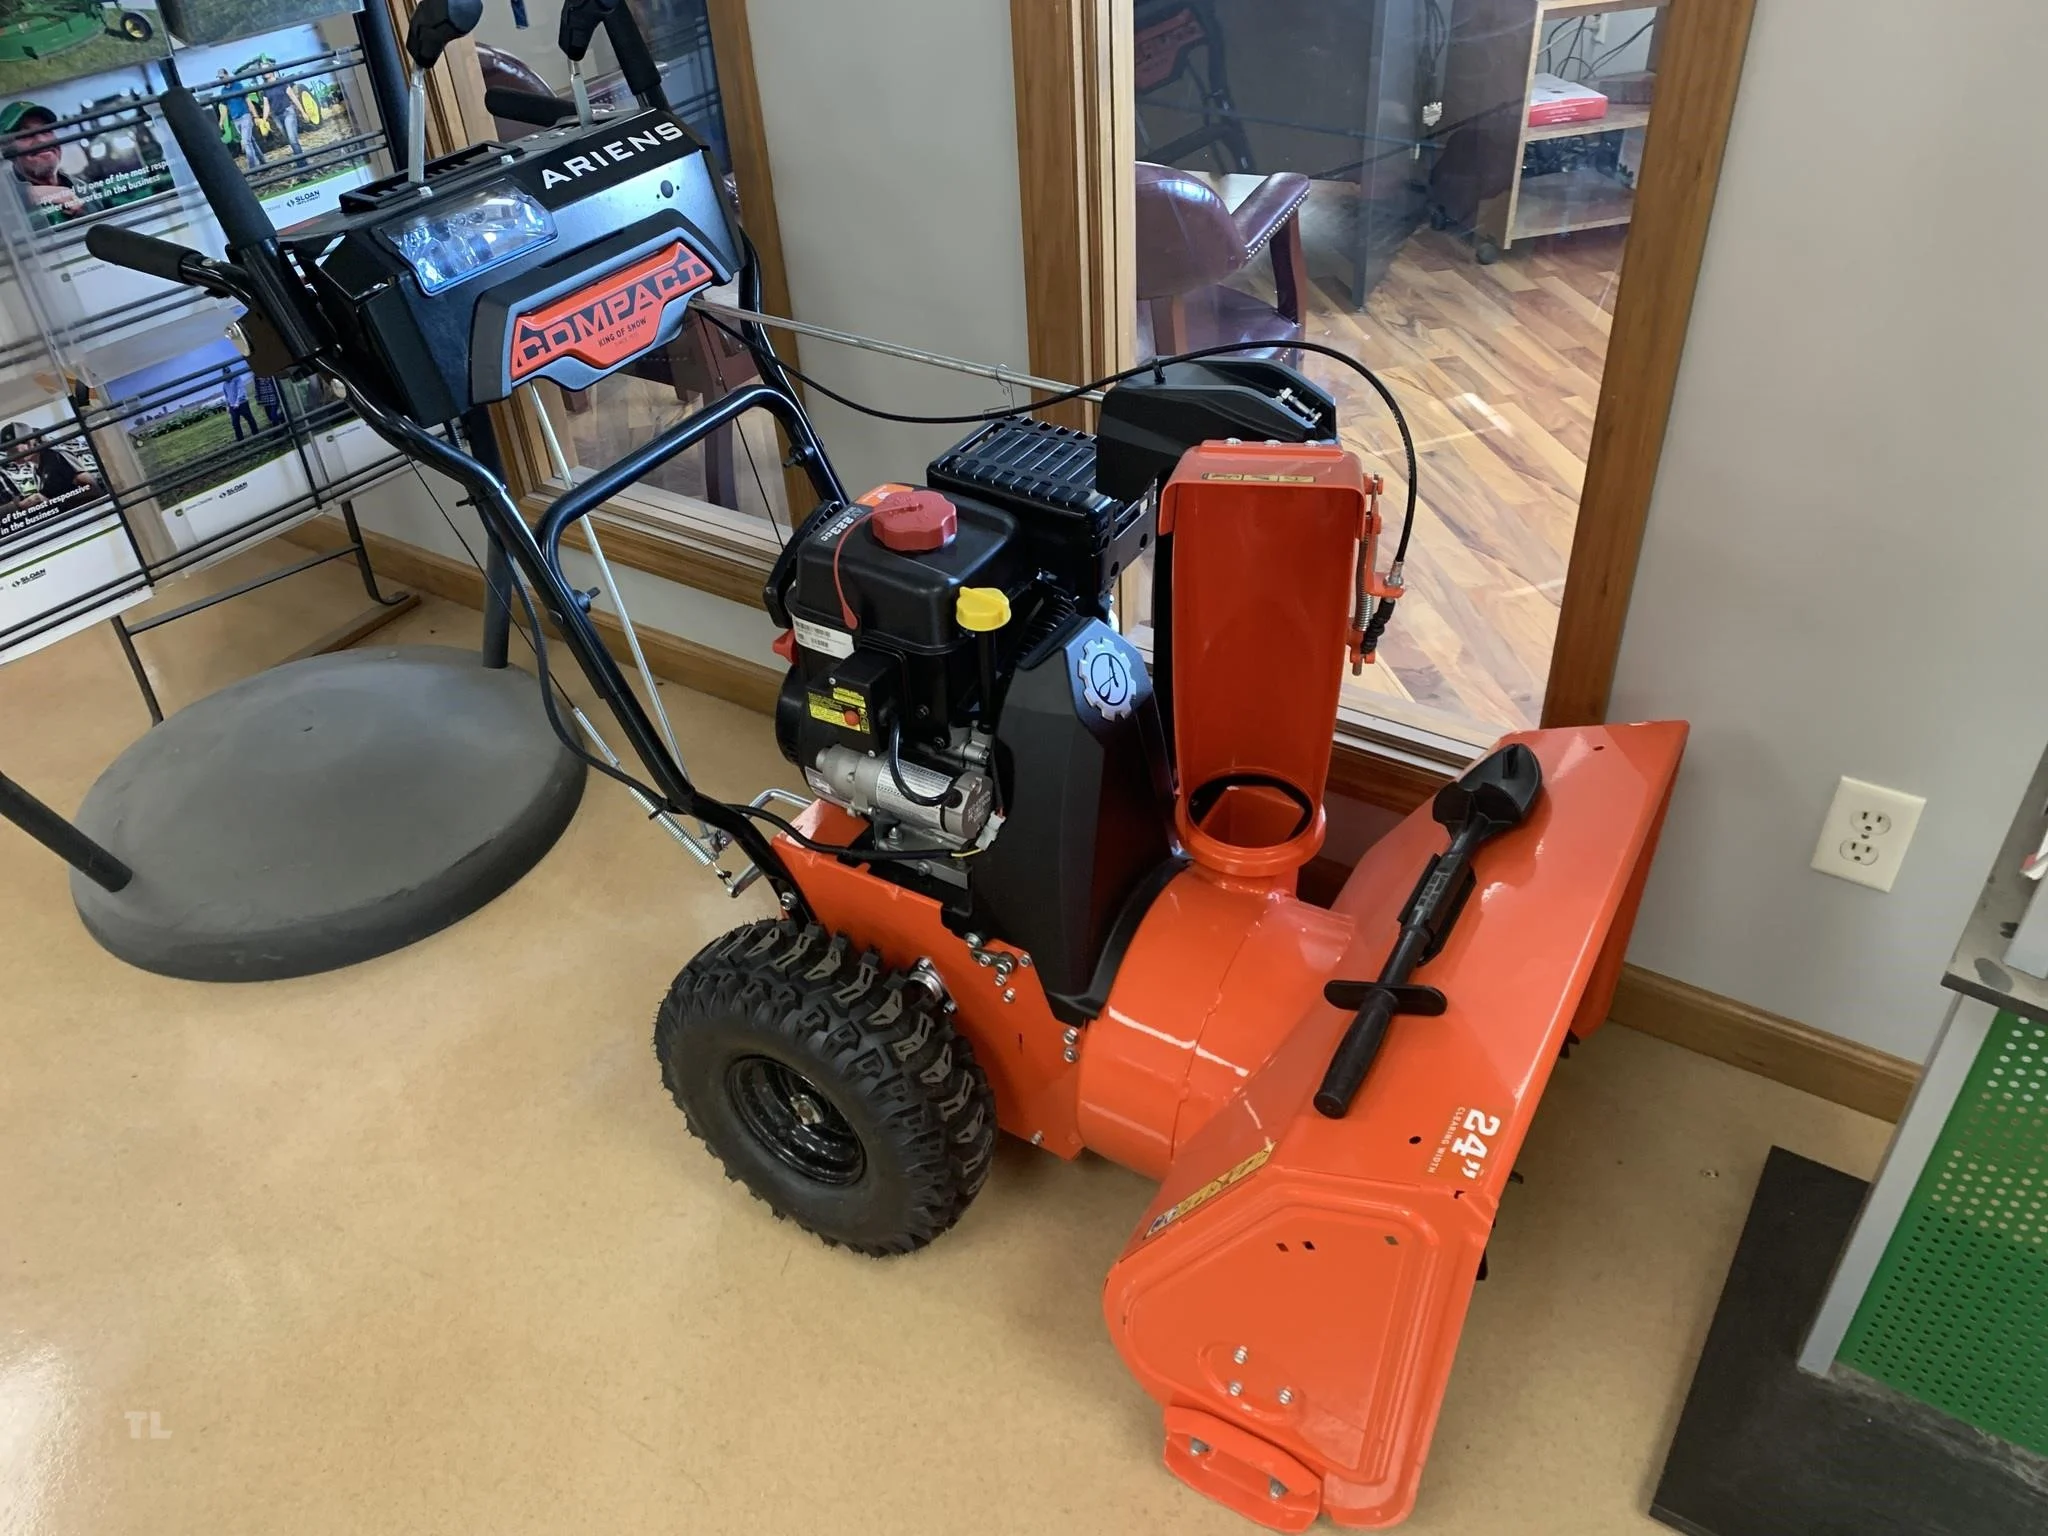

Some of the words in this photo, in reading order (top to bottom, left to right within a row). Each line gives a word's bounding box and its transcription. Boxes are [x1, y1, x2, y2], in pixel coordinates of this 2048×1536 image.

[542, 121, 684, 190] ARIENS
[77, 183, 87, 194] by
[88, 180, 104, 190] one
[105, 174, 114, 185] of
[115, 171, 130, 182] the
[130, 165, 150, 178] most
[103, 188, 113, 197] in
[113, 183, 128, 194] the
[128, 173, 161, 190] business
[294, 189, 321, 204] SLOAN
[517, 259, 706, 363] COMPACT
[598, 333, 615, 348] KING
[616, 327, 625, 338] OF
[627, 316, 647, 332] SNOW
[2, 514, 12, 524] of
[12, 508, 27, 520] the
[27, 500, 48, 514] most
[48, 484, 91, 506] responsive
[0, 526, 9, 536] in
[10, 520, 25, 532] the
[25, 506, 60, 525] business
[820, 516, 854, 542] 223cc
[1441, 1105, 1466, 1146] CLEARING
[1427, 1146, 1446, 1175] WIDTH
